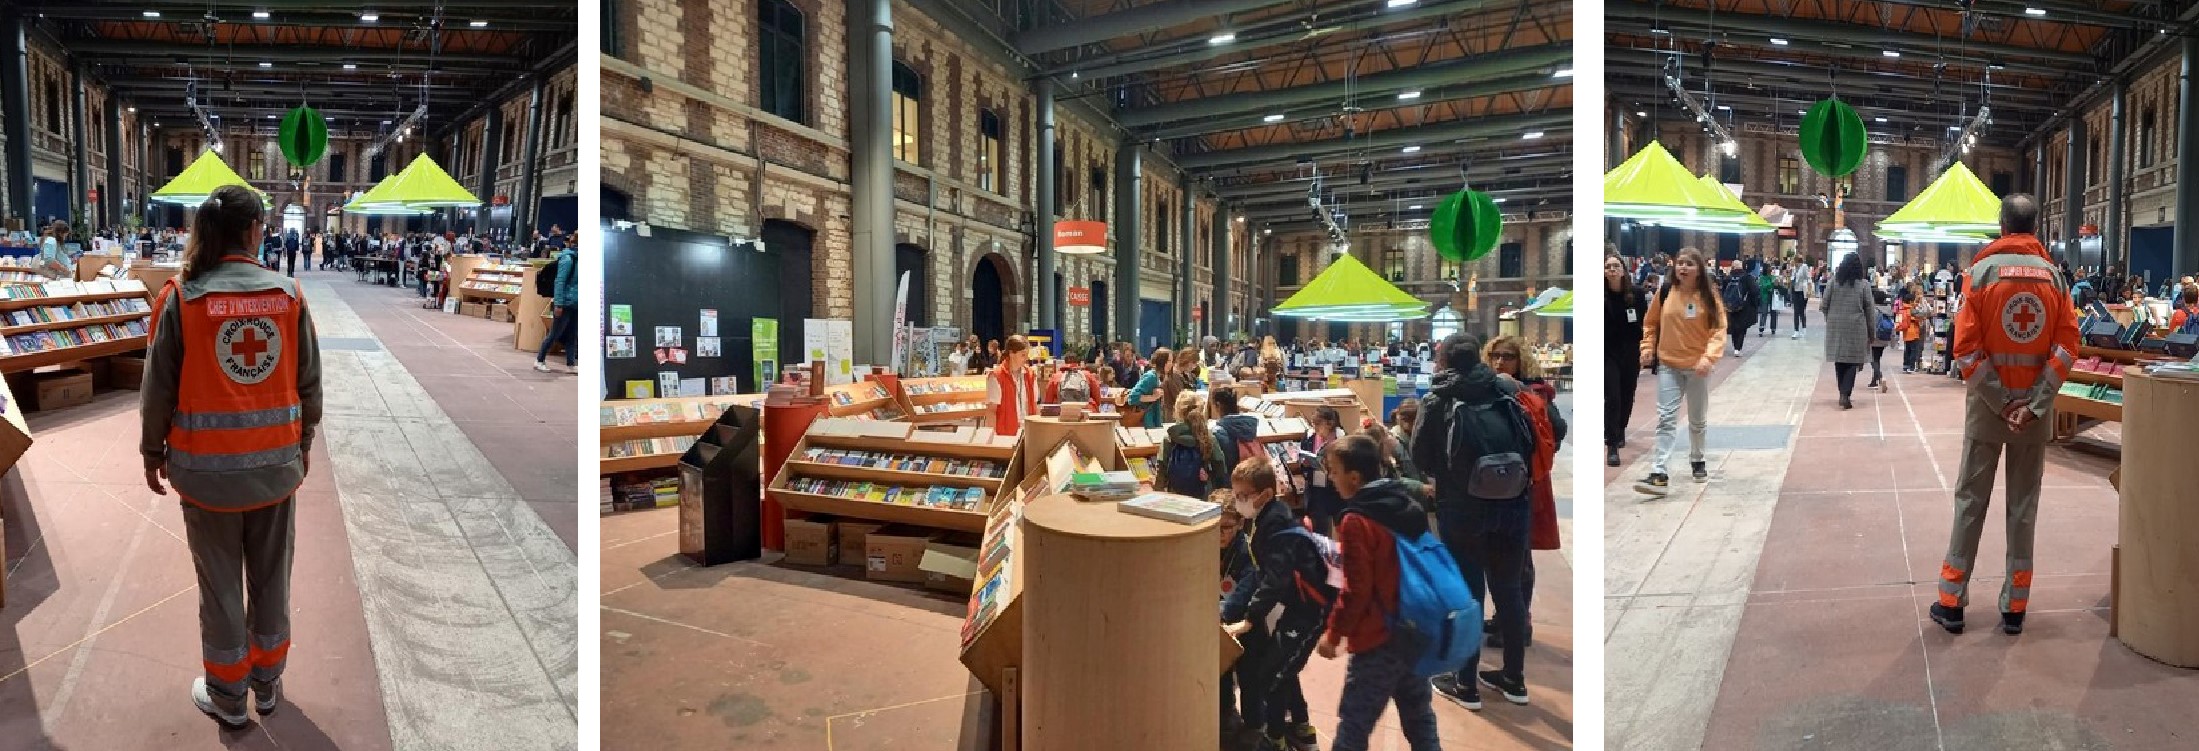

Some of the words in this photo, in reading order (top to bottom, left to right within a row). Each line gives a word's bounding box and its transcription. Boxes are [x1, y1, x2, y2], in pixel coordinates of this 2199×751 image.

[207, 299, 227, 315] CHEF
[229, 296, 289, 314] D'INTERVENTION
[1070, 291, 1089, 302] CAISSE
[222, 318, 275, 345] CROIX-ROUGE
[2006, 322, 2040, 340] FRANÇAISE
[226, 354, 275, 379] FRANÇAISE
